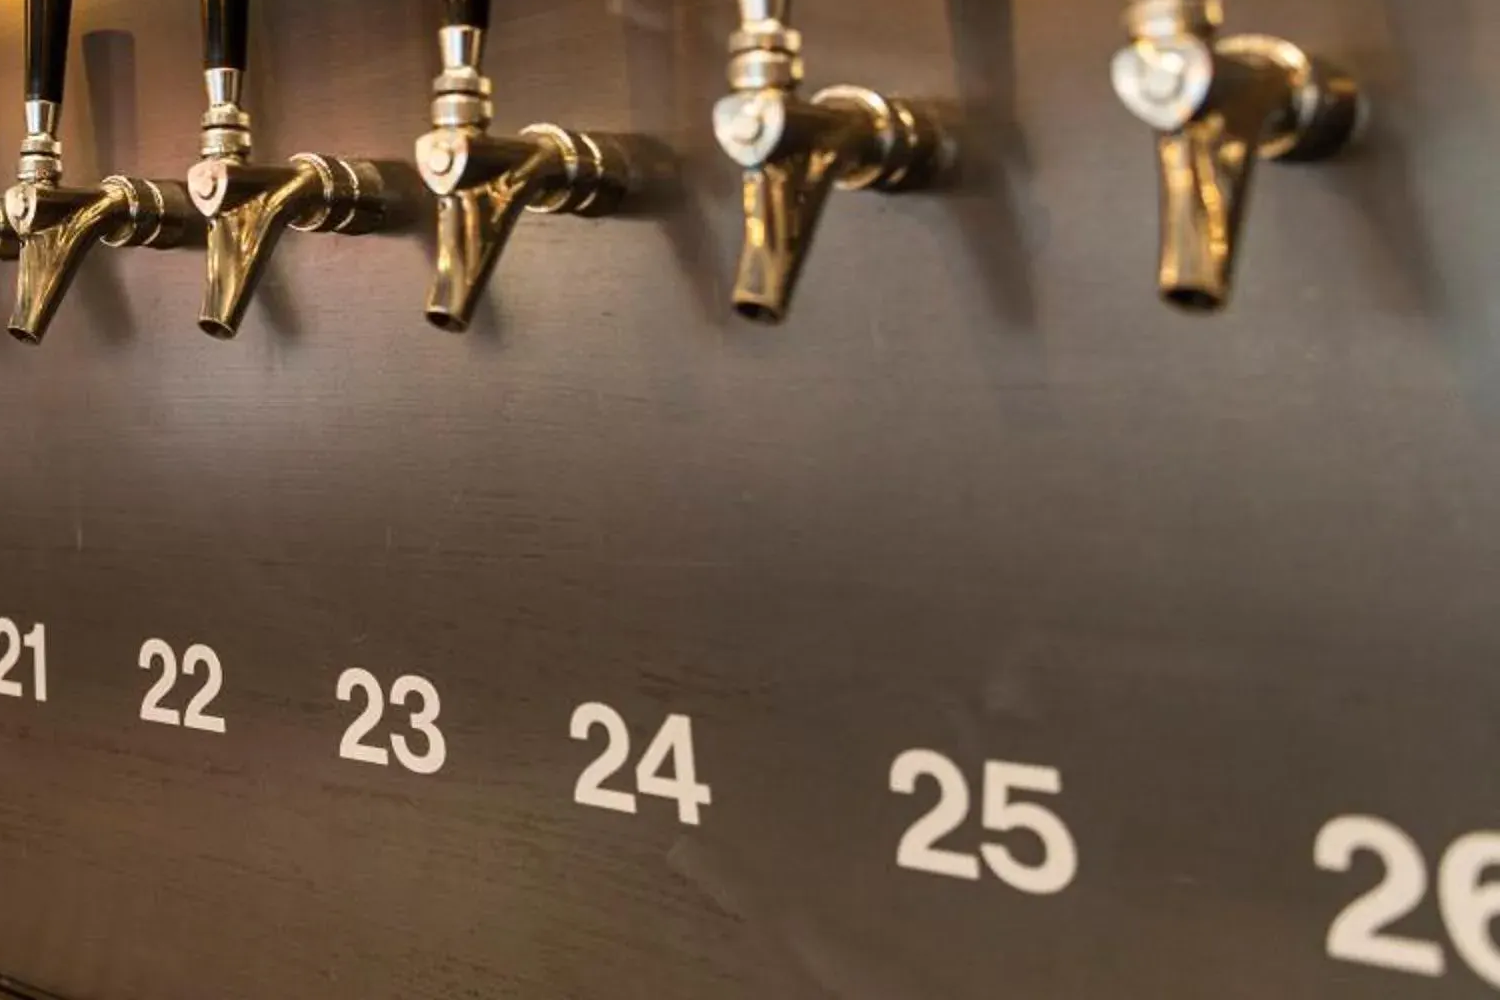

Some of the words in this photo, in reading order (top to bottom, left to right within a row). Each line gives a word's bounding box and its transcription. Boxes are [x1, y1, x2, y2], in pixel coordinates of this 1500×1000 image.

[138, 638, 226, 733] 22
[336, 668, 446, 773] 23
[570, 702, 711, 825] 24
[890, 748, 1077, 894] 25
